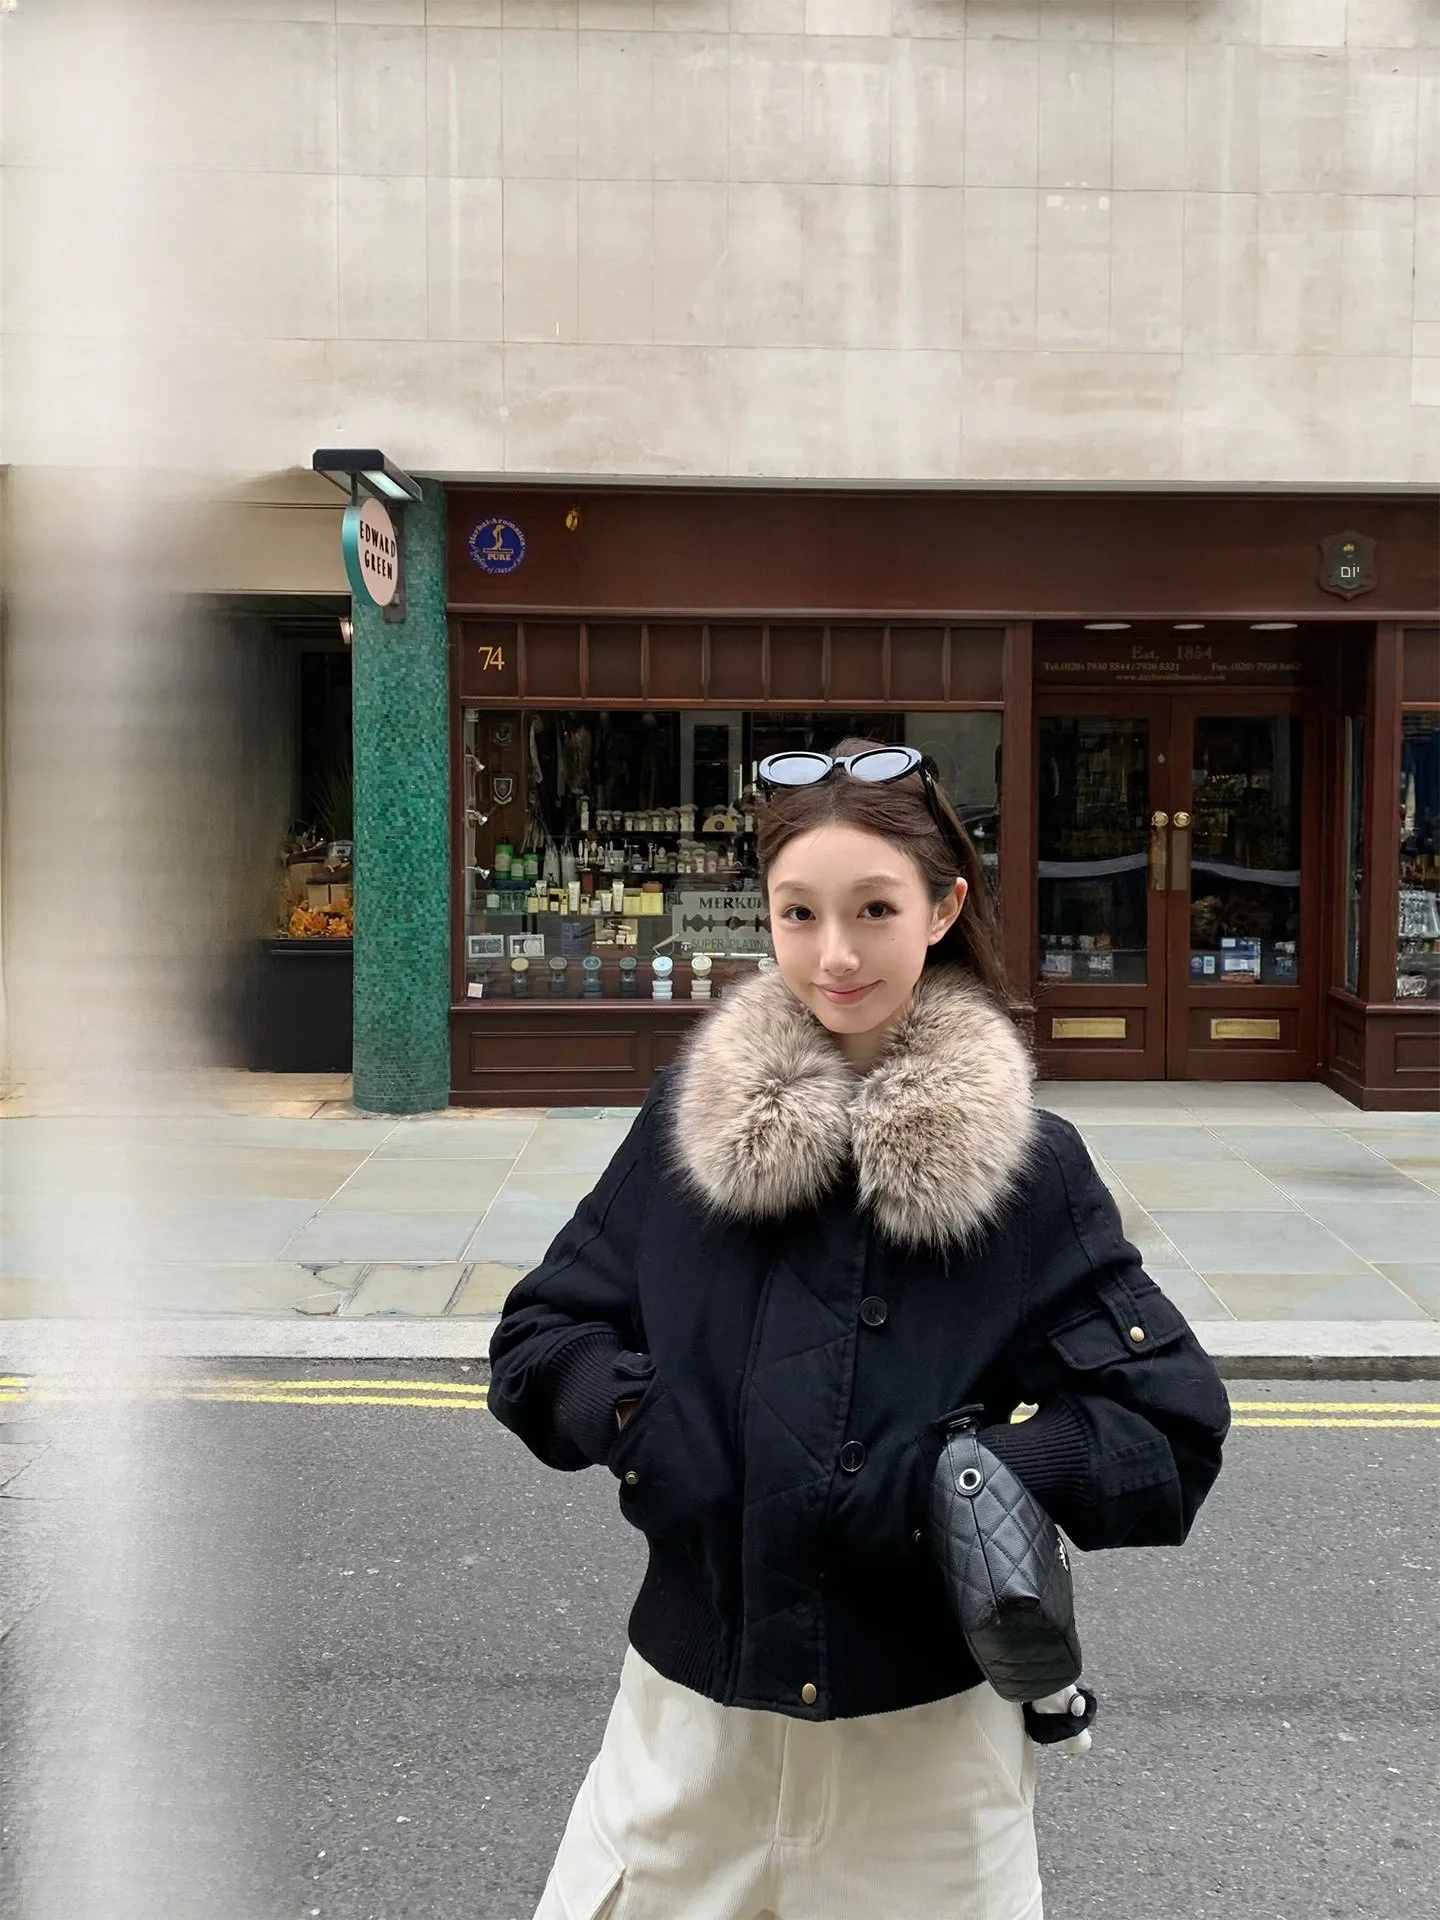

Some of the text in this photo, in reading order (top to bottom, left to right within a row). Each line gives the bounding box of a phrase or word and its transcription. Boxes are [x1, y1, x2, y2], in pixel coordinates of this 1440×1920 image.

[359, 520, 396, 558] EDWARD
[364, 550, 393, 580] GREEN
[487, 553, 512, 561] PURE
[478, 646, 505, 671] 74
[1177, 645, 1212, 660] 1854
[691, 938, 724, 949] SUPER
